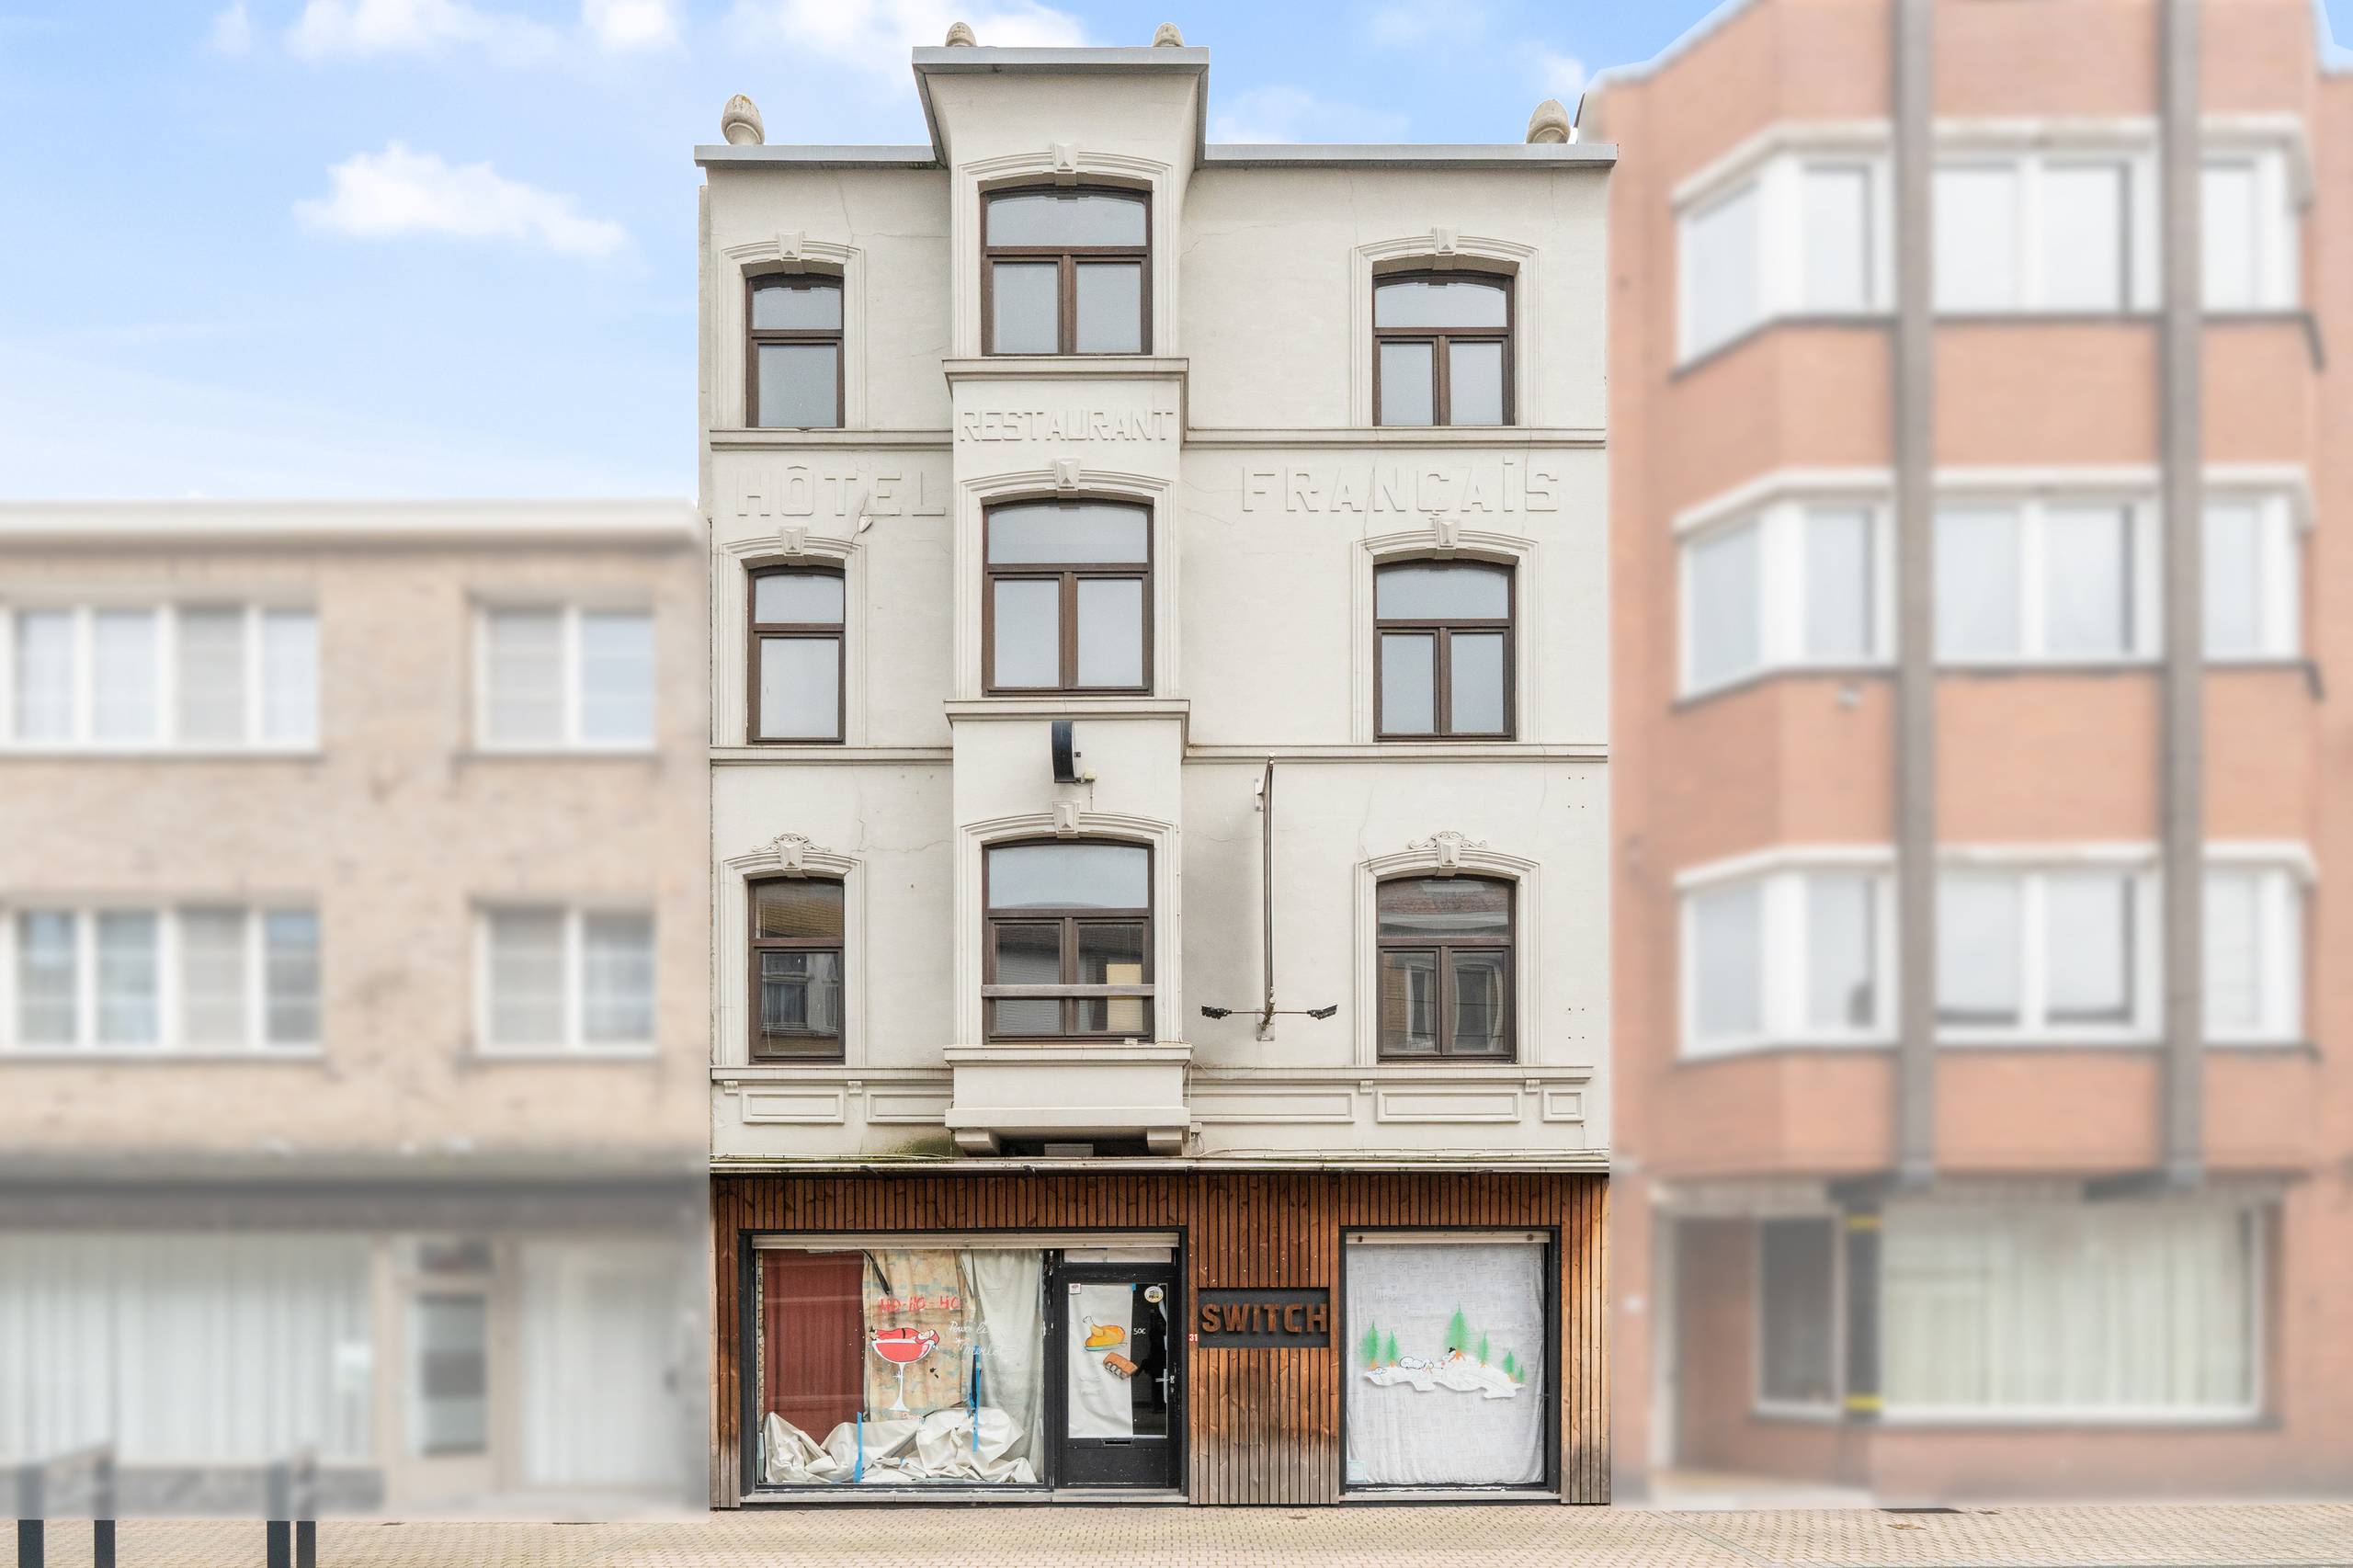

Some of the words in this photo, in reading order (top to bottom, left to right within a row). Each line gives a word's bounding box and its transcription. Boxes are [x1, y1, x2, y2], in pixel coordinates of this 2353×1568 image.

[958, 410, 1176, 441] RESTAURANT
[735, 464, 946, 517] HÔTEL
[1201, 1303, 1328, 1333] SWITCH
